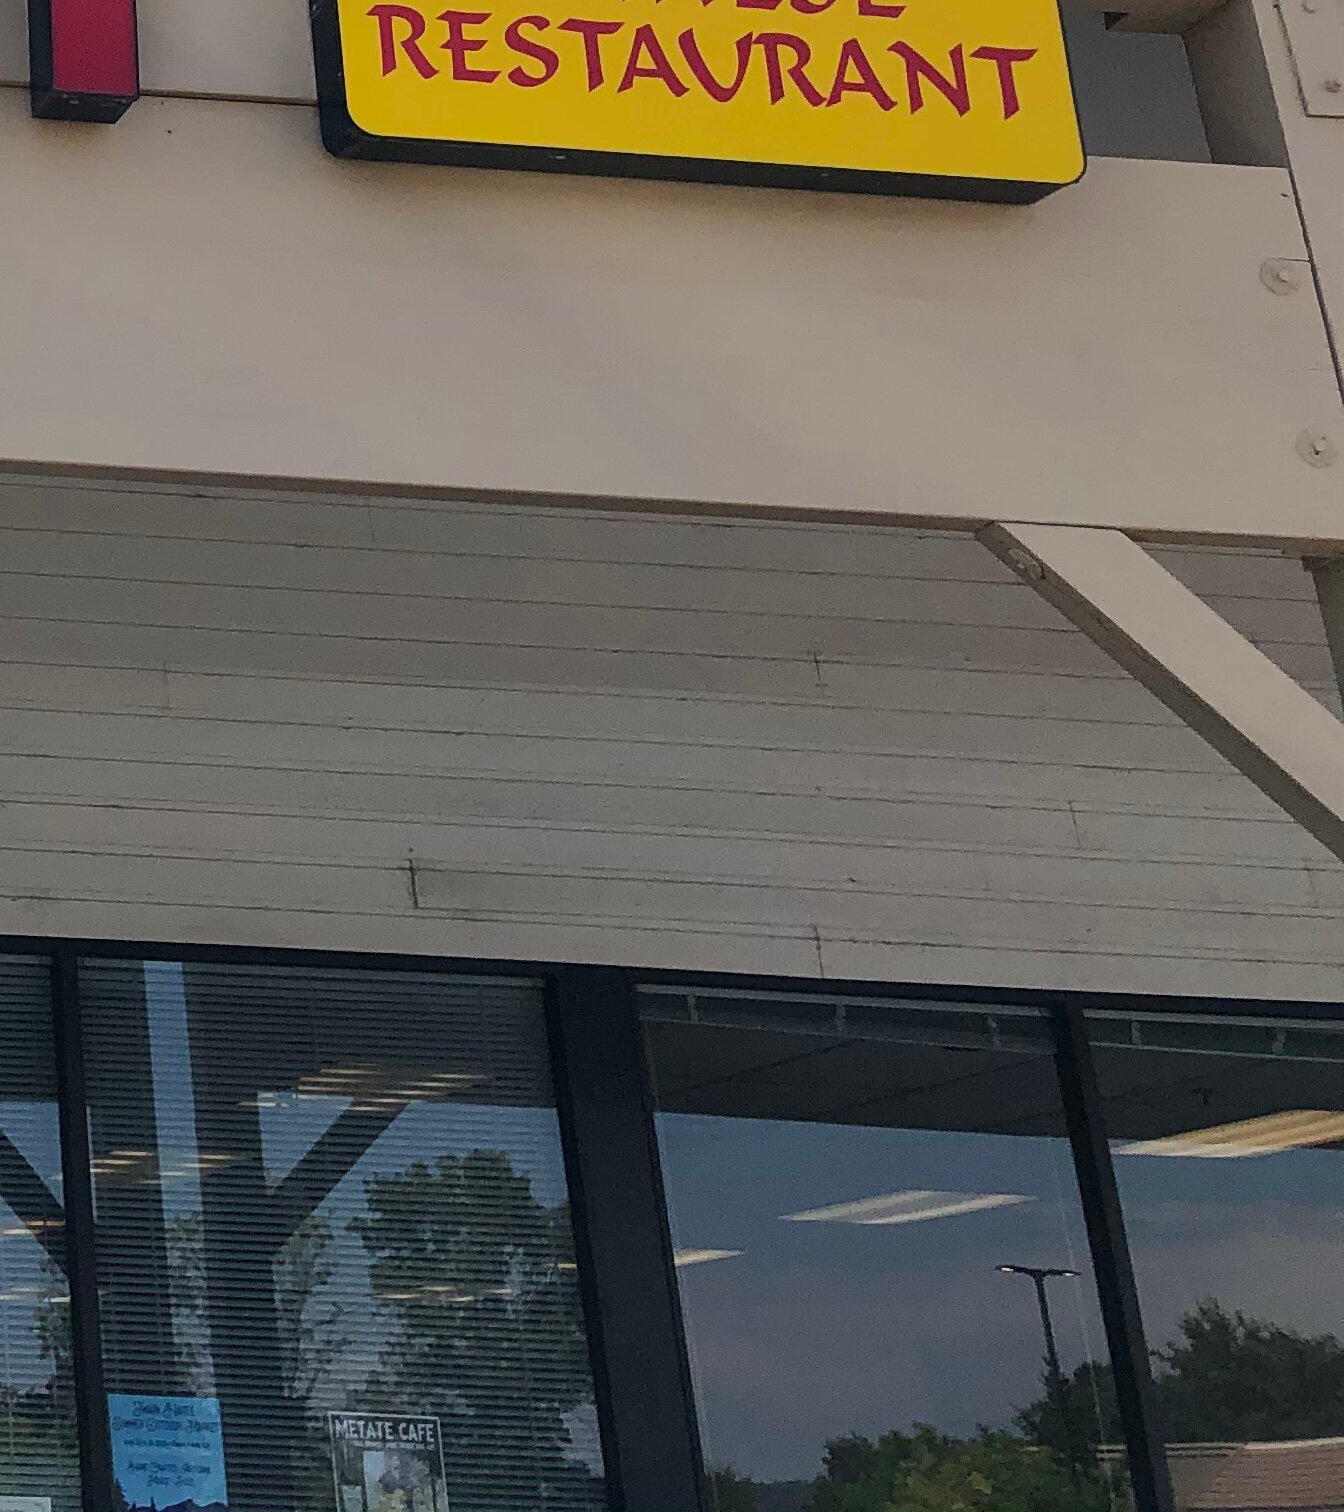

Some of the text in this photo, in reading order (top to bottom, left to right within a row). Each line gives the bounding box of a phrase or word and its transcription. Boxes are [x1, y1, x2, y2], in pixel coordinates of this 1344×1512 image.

[365, 2, 1039, 120] RESTAURANT
[334, 1418, 435, 1443] METATE CAFE
